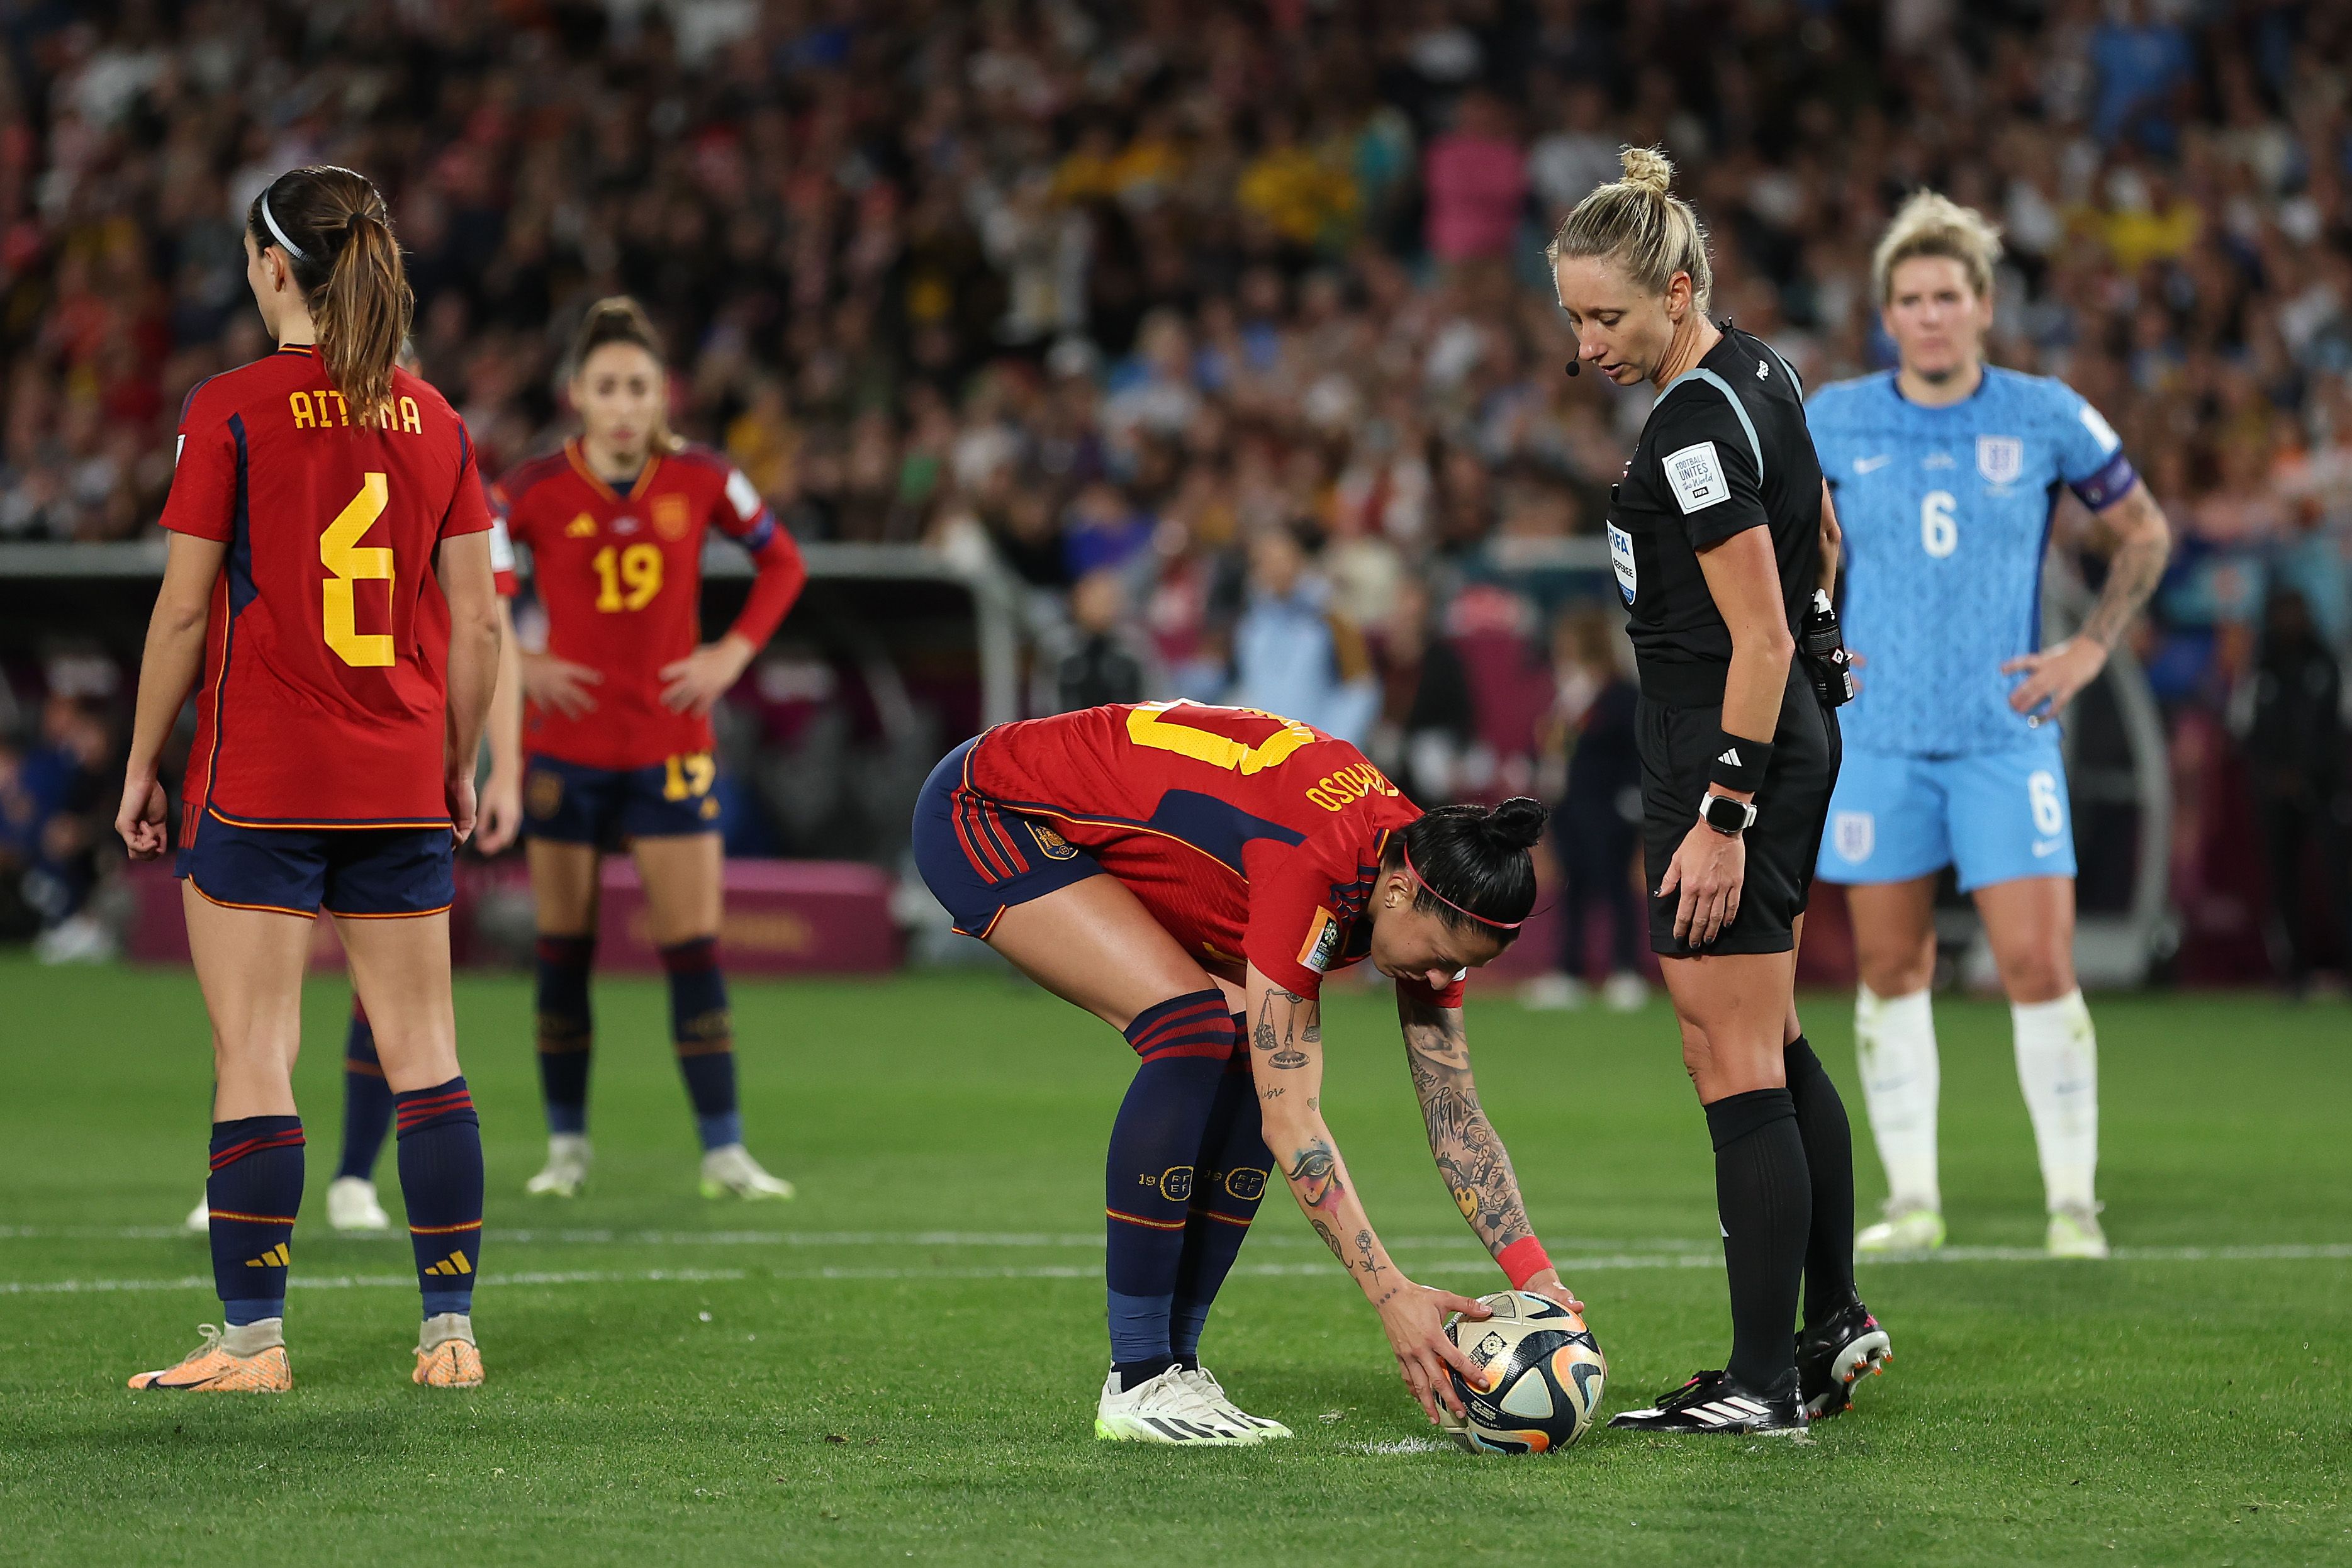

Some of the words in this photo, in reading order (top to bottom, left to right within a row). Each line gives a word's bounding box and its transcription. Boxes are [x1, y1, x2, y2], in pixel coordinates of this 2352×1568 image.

[289, 390, 422, 434] AITNA
[1676, 454, 1705, 470] FOOTBALL
[1679, 462, 1708, 481] UNITES
[1683, 481, 1693, 490] the
[1692, 473, 1713, 487] World
[1694, 488, 1707, 497] FIFA
[1921, 490, 1957, 558] 6
[1609, 527, 1630, 556] FIFA
[320, 472, 395, 667] 6
[592, 543, 664, 613] 19
[663, 751, 716, 802] 19
[2027, 771, 2063, 836] 6
[1261, 1084, 1286, 1100] libre
[1138, 1173, 1156, 1185] 19
